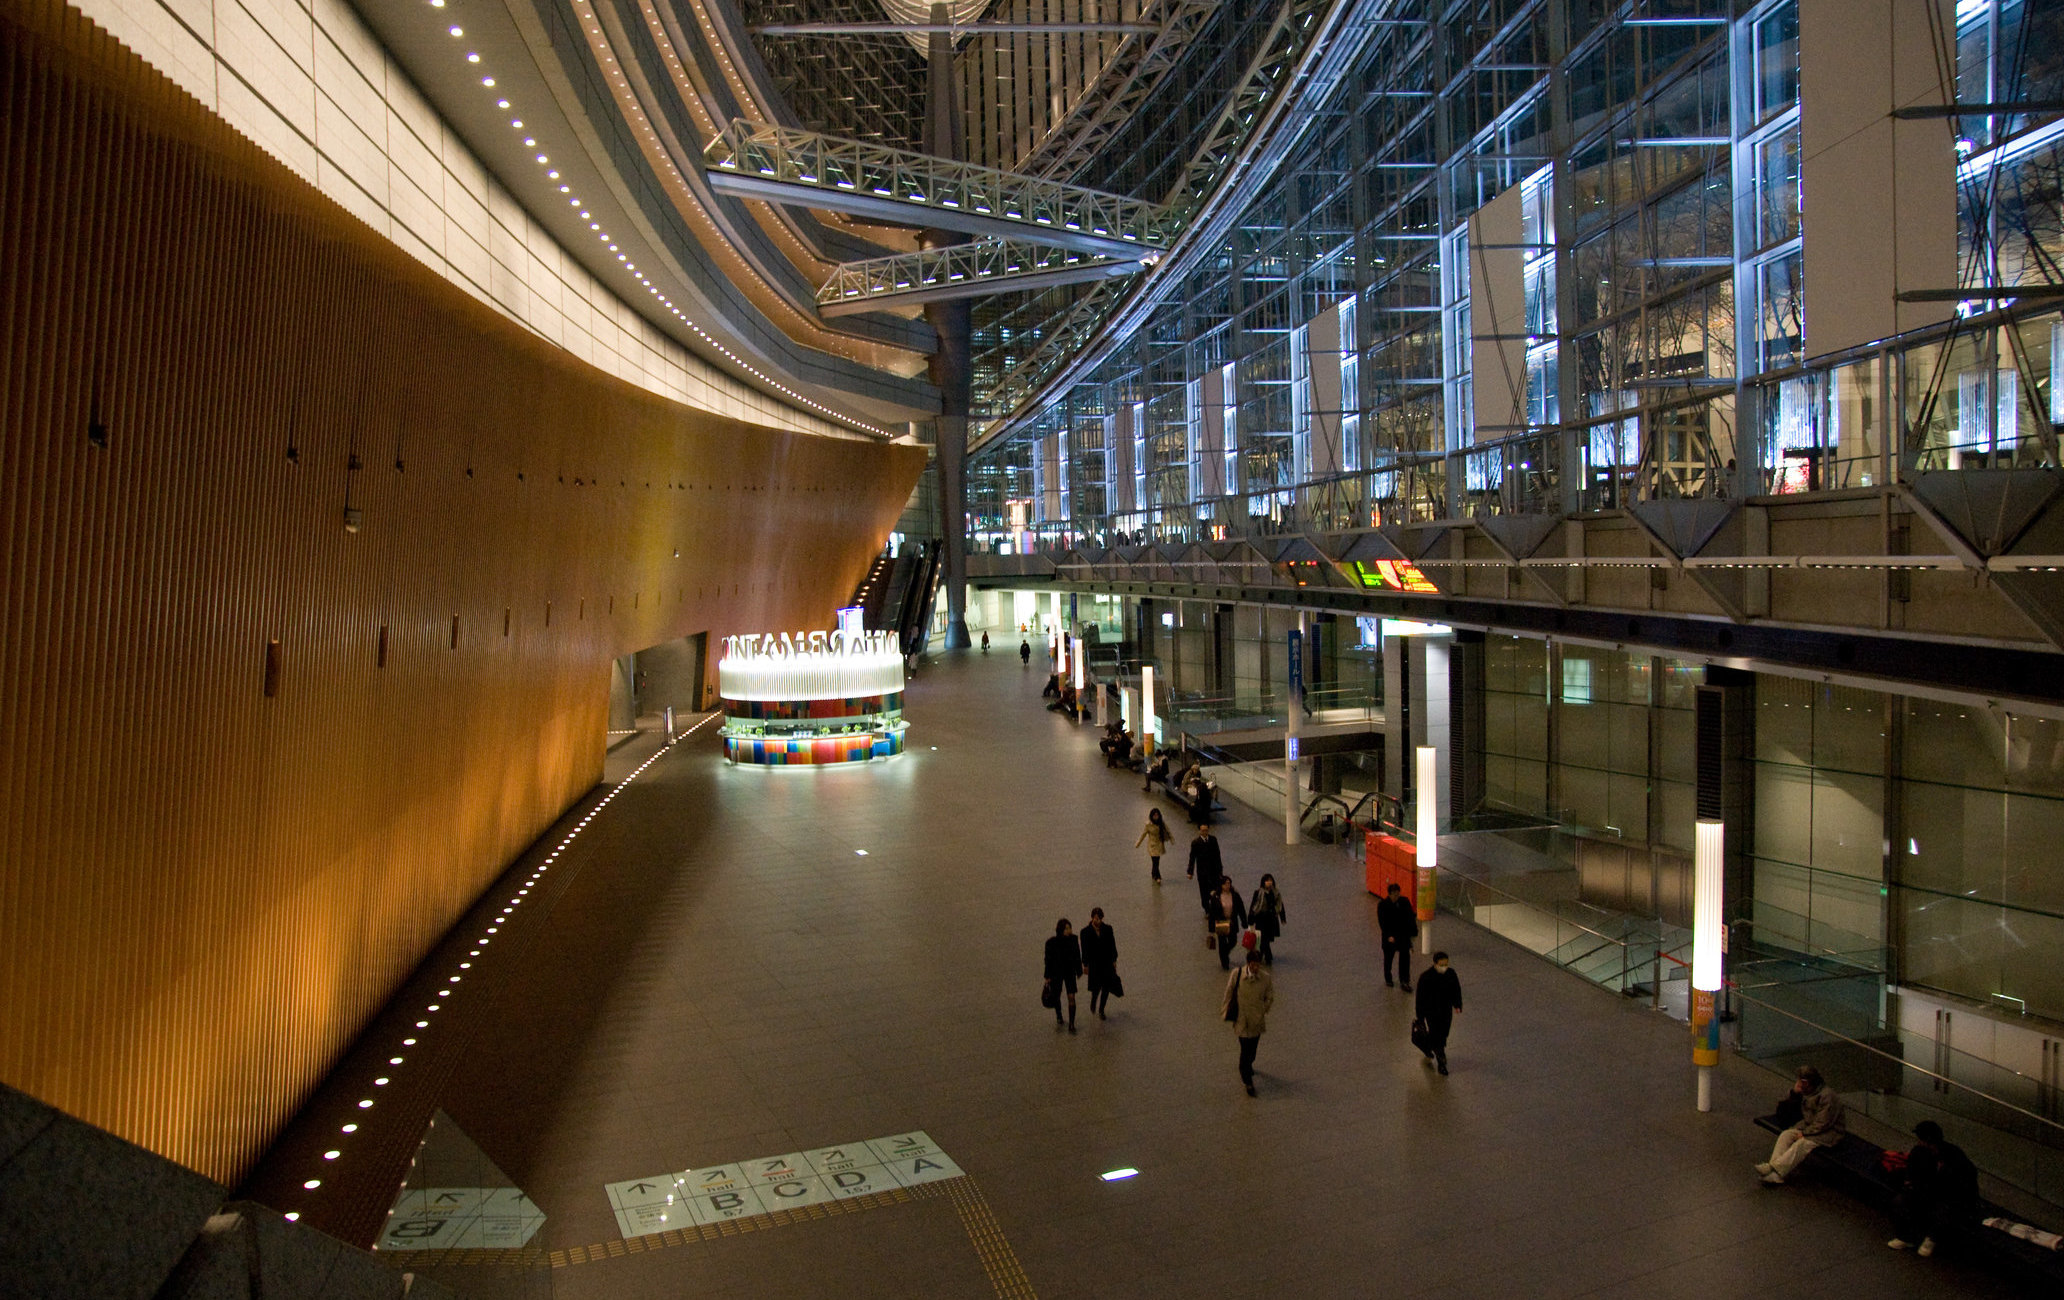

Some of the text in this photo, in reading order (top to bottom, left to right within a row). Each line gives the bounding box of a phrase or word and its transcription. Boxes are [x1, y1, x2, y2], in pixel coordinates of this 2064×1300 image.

[729, 630, 900, 661] INFORMATIO
[913, 1158, 944, 1174] A
[832, 1171, 866, 1188] D
[707, 1183, 734, 1193] hall
[773, 1182, 807, 1197] C
[709, 1192, 744, 1210] B
